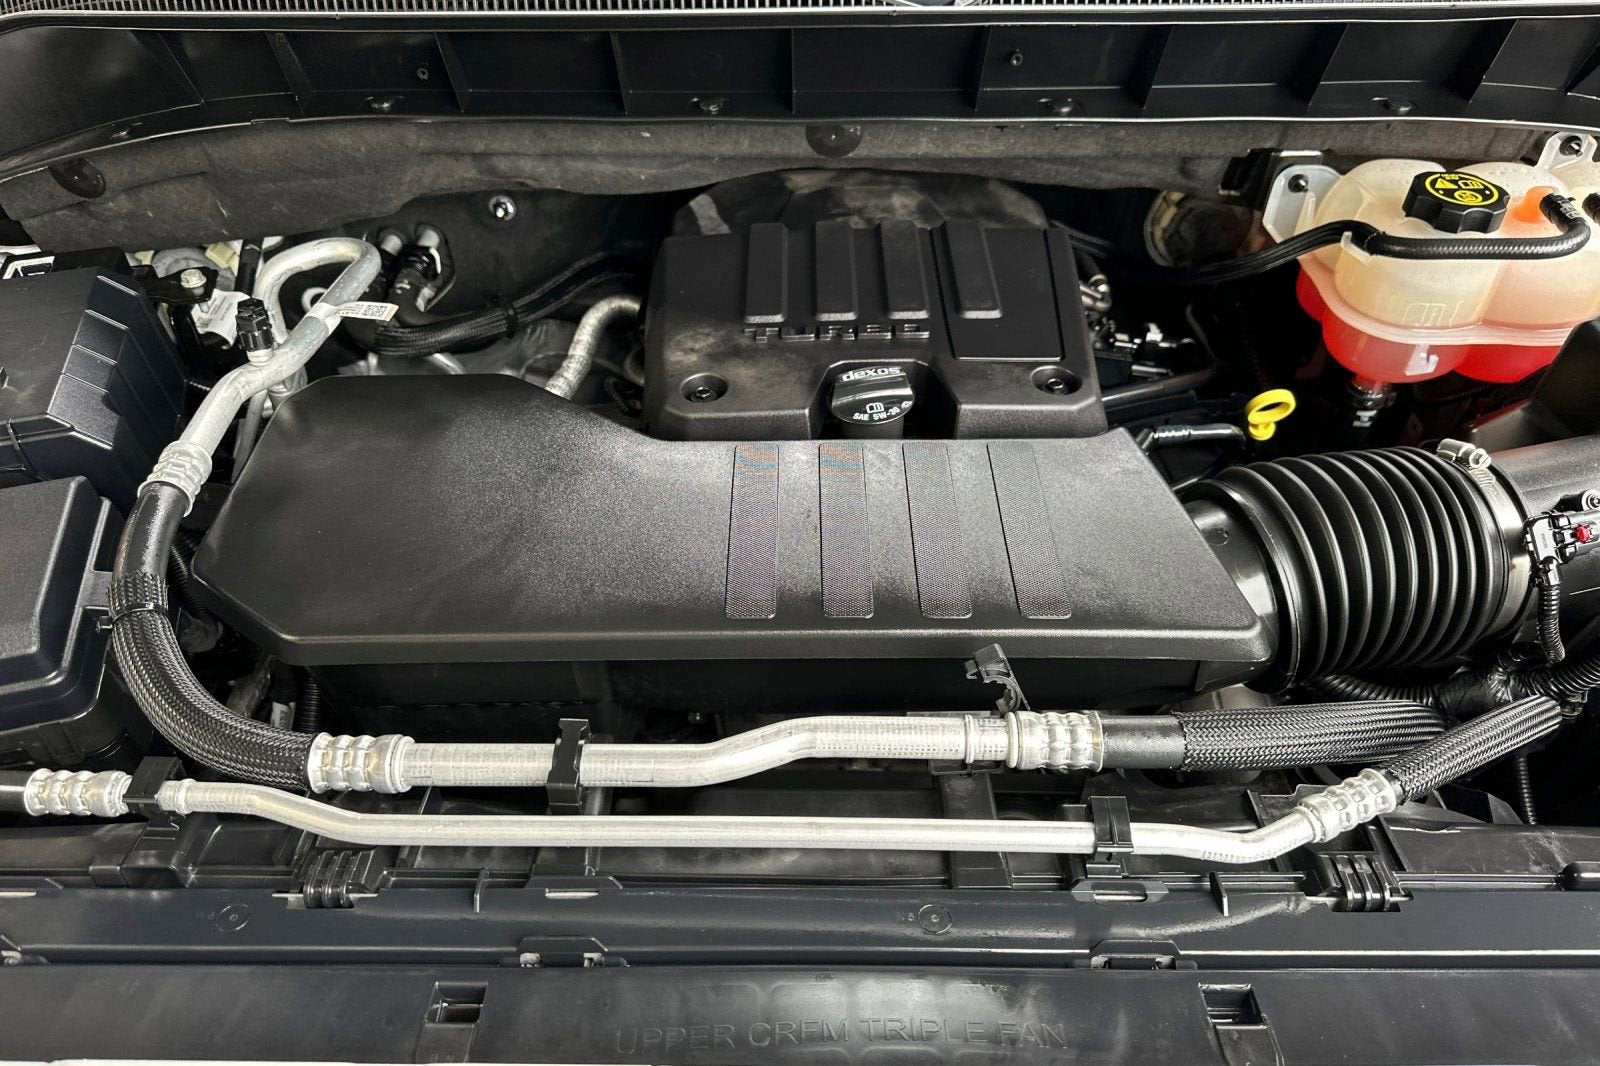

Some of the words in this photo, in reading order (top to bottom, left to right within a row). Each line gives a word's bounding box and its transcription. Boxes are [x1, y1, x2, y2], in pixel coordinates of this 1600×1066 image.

[842, 366, 901, 382] dexos
[853, 412, 870, 421] SAE
[615, 1023, 736, 1055] UPPER
[859, 1017, 989, 1044] TRIPLE
[998, 1020, 1069, 1049] FAN
